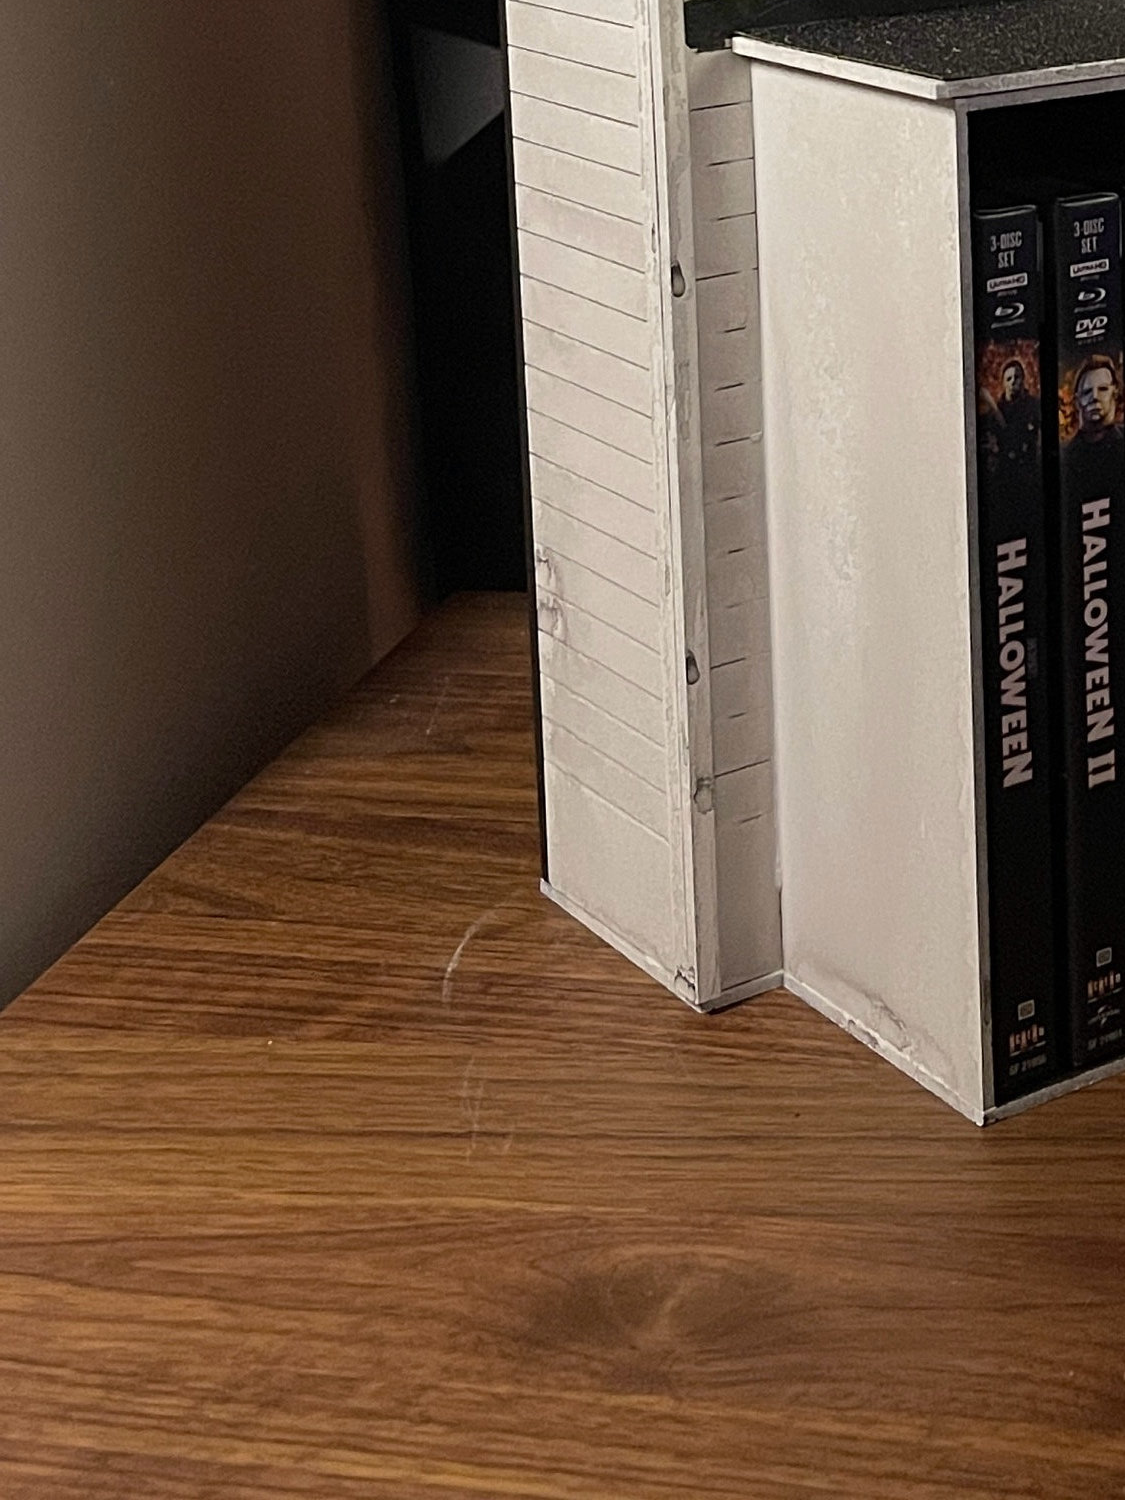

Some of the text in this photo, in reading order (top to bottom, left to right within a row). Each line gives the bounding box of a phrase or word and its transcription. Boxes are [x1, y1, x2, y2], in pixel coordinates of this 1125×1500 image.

[1081, 237, 1098, 254] SET
[998, 252, 1016, 268] SET
[1075, 315, 1109, 332] DVD
[1080, 497, 1116, 790] HALLOWEEN II
[996, 537, 1033, 789] HALLOWEEN
